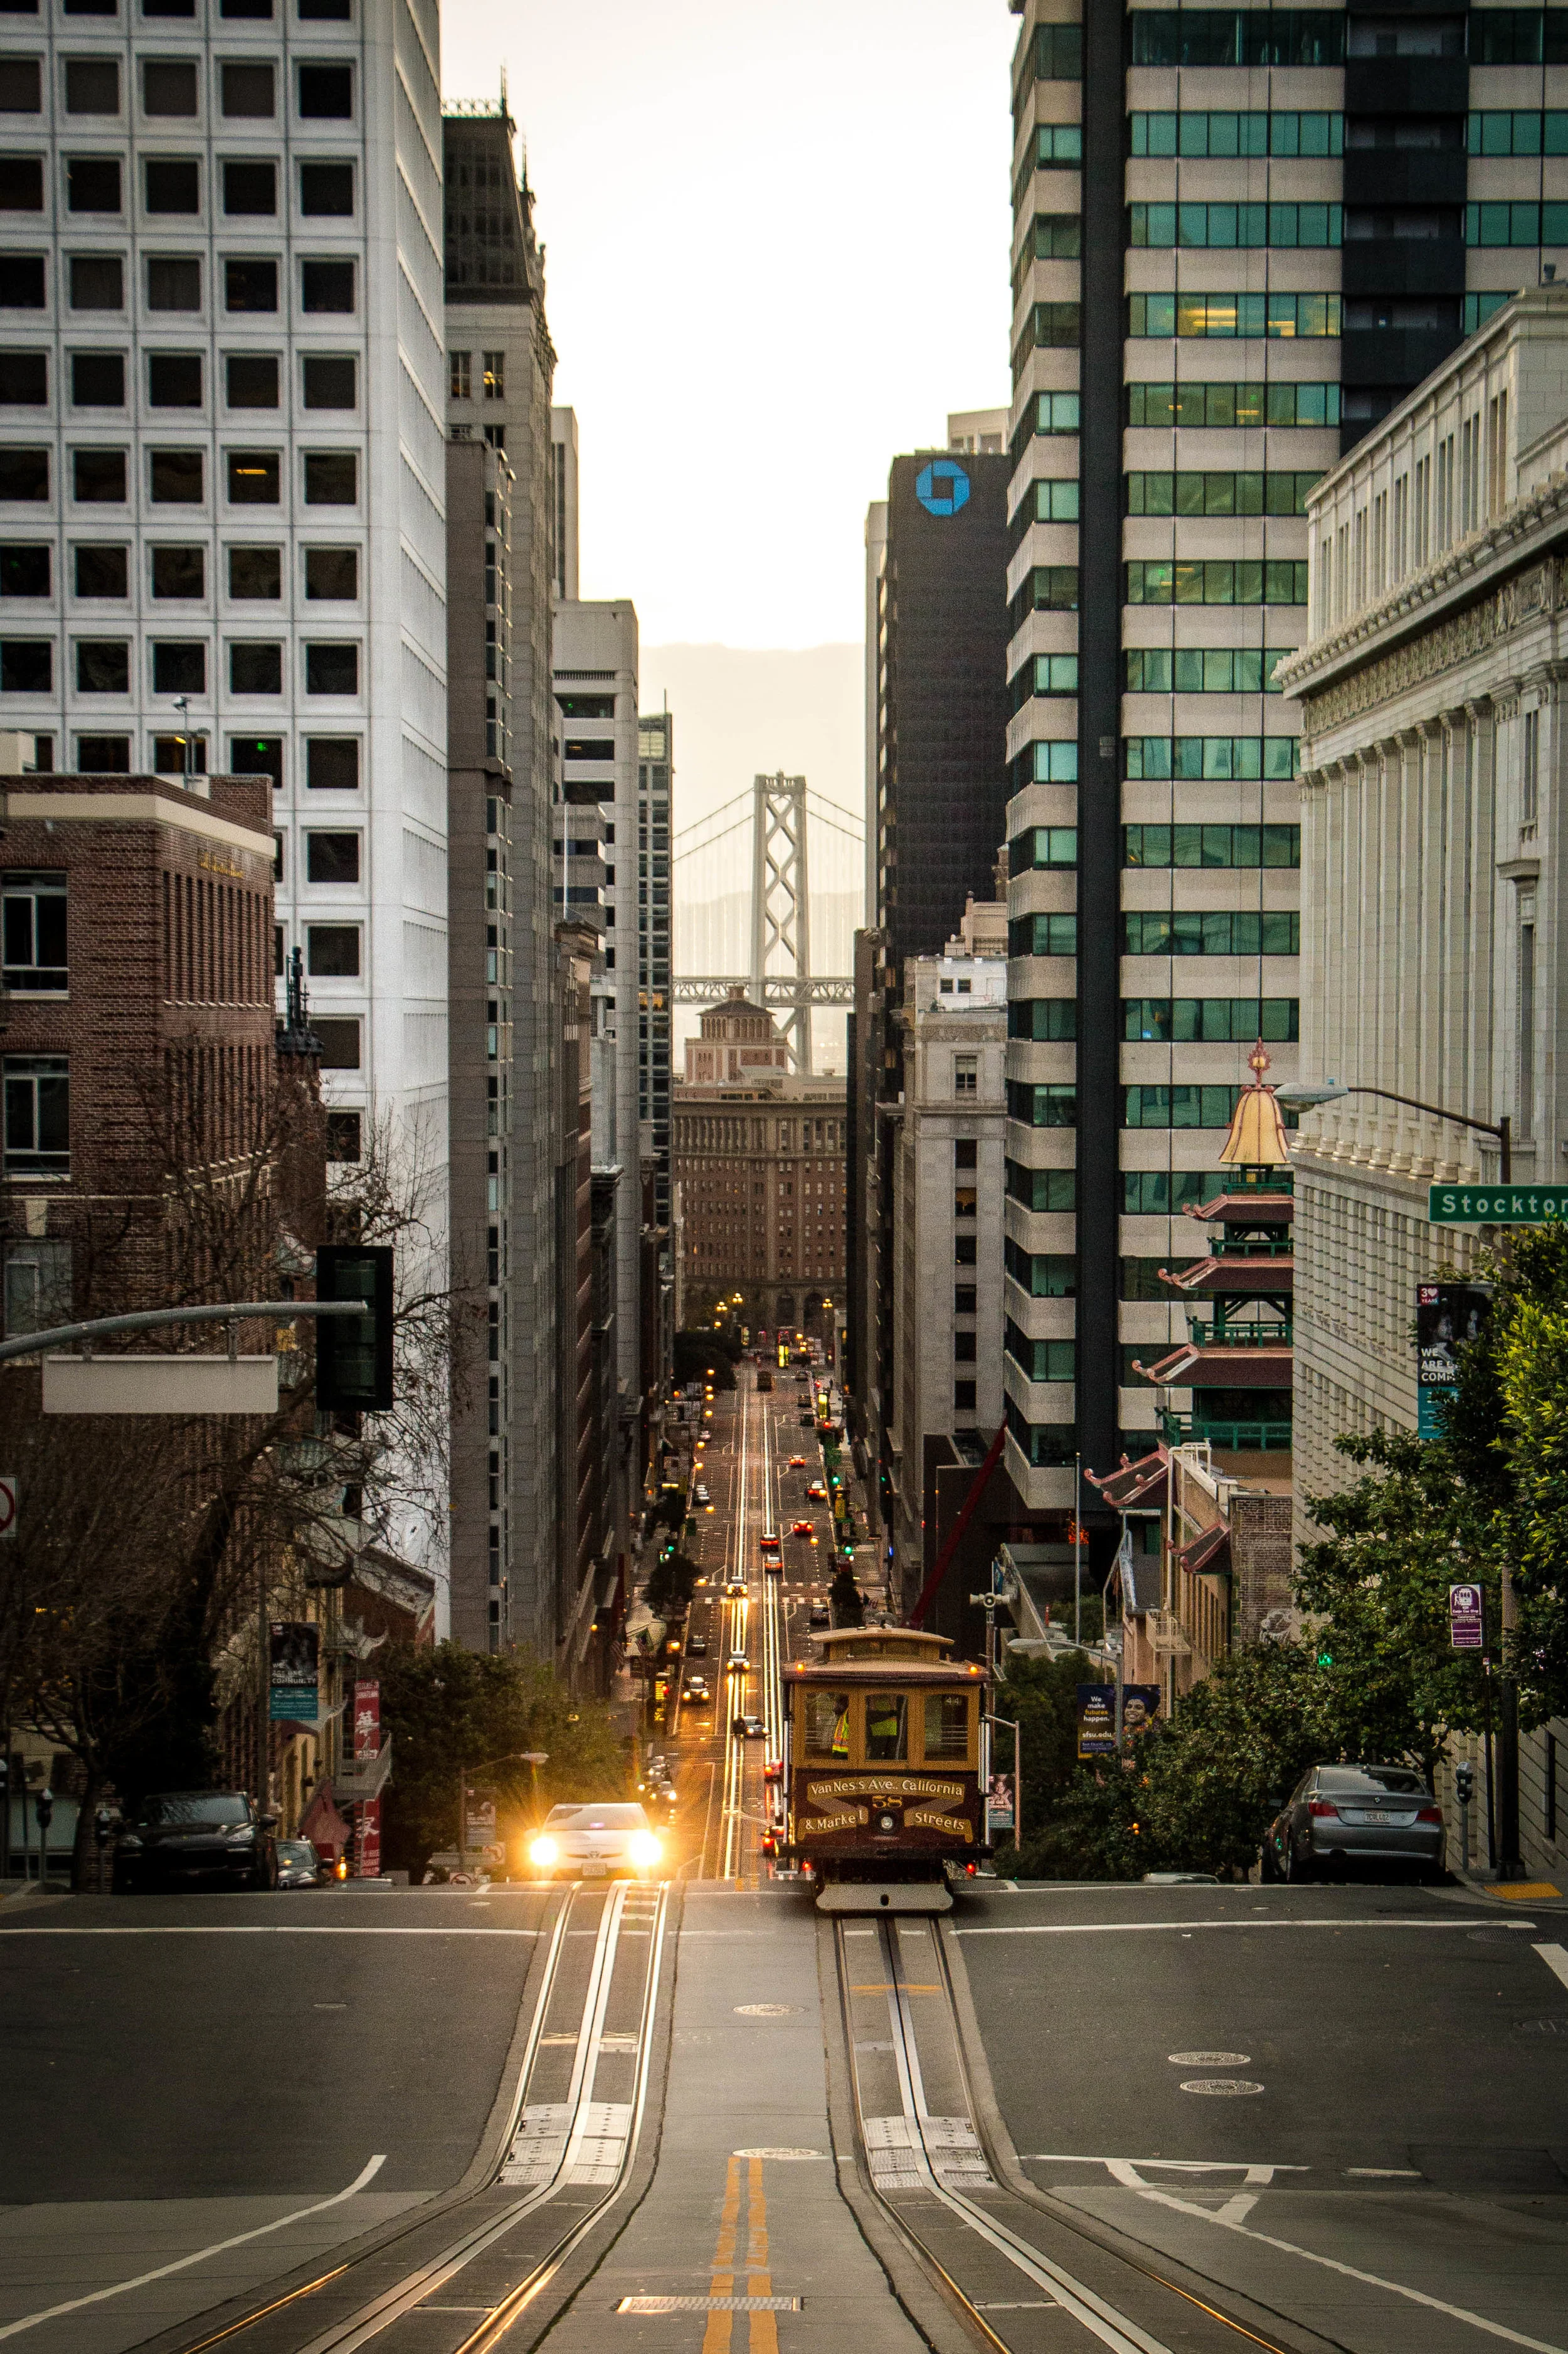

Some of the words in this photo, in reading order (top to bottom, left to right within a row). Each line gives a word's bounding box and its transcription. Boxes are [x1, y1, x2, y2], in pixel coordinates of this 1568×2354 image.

[1421, 1348, 1438, 1357] WE
[1421, 1360, 1444, 1370] ARE
[1083, 1715, 1110, 1723] happen.
[811, 1784, 832, 1794] Van
[834, 1781, 864, 1792] Ness
[902, 1780, 963, 1796] California
[872, 1795, 903, 1808] 58
[805, 1819, 814, 1830] &
[817, 1809, 864, 1829] Market
[914, 1812, 965, 1830] Streets
